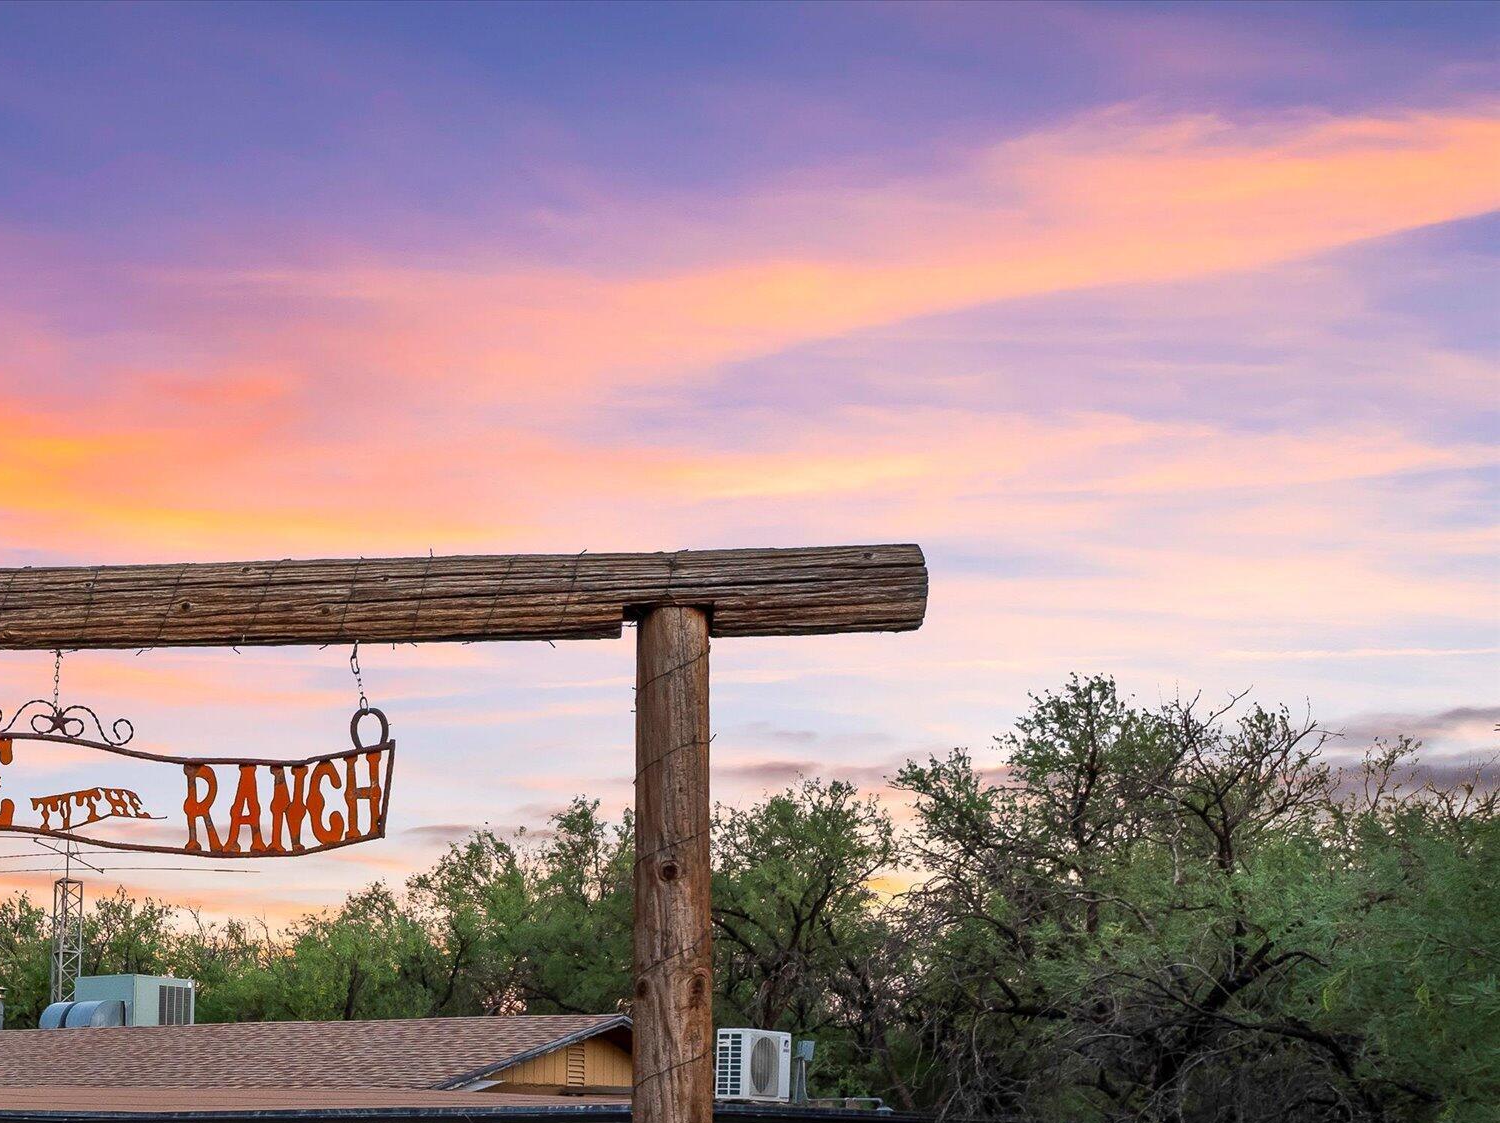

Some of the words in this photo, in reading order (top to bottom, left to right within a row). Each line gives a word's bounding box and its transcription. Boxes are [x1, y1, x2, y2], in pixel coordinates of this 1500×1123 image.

[30, 793, 72, 832] TO
[75, 787, 151, 822] THE
[183, 751, 382, 853] RANCH
